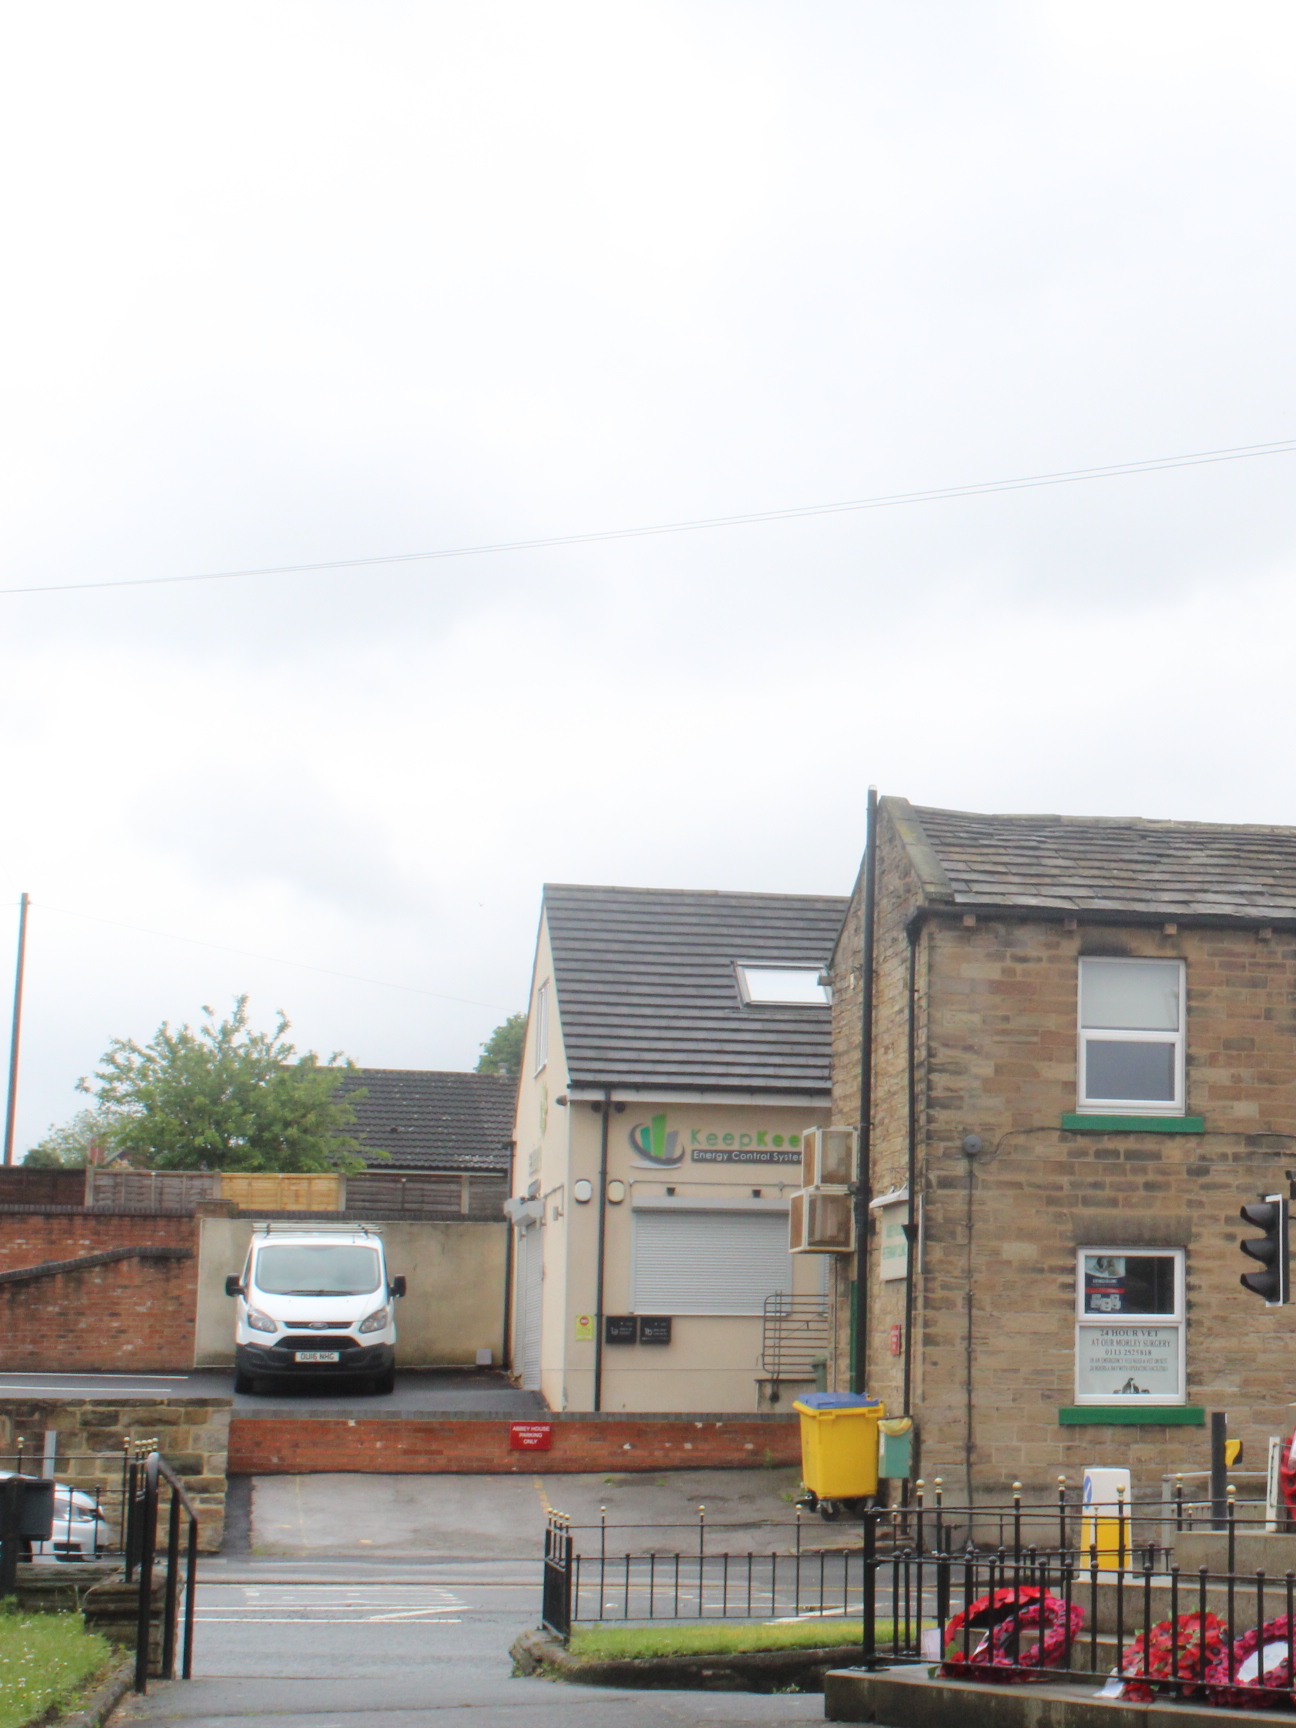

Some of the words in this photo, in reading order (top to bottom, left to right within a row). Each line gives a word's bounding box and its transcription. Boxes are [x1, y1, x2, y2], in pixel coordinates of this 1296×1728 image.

[690, 1129, 801, 1149] KeepKee
[693, 1151, 729, 1161] Energy
[732, 1151, 771, 1161] Control
